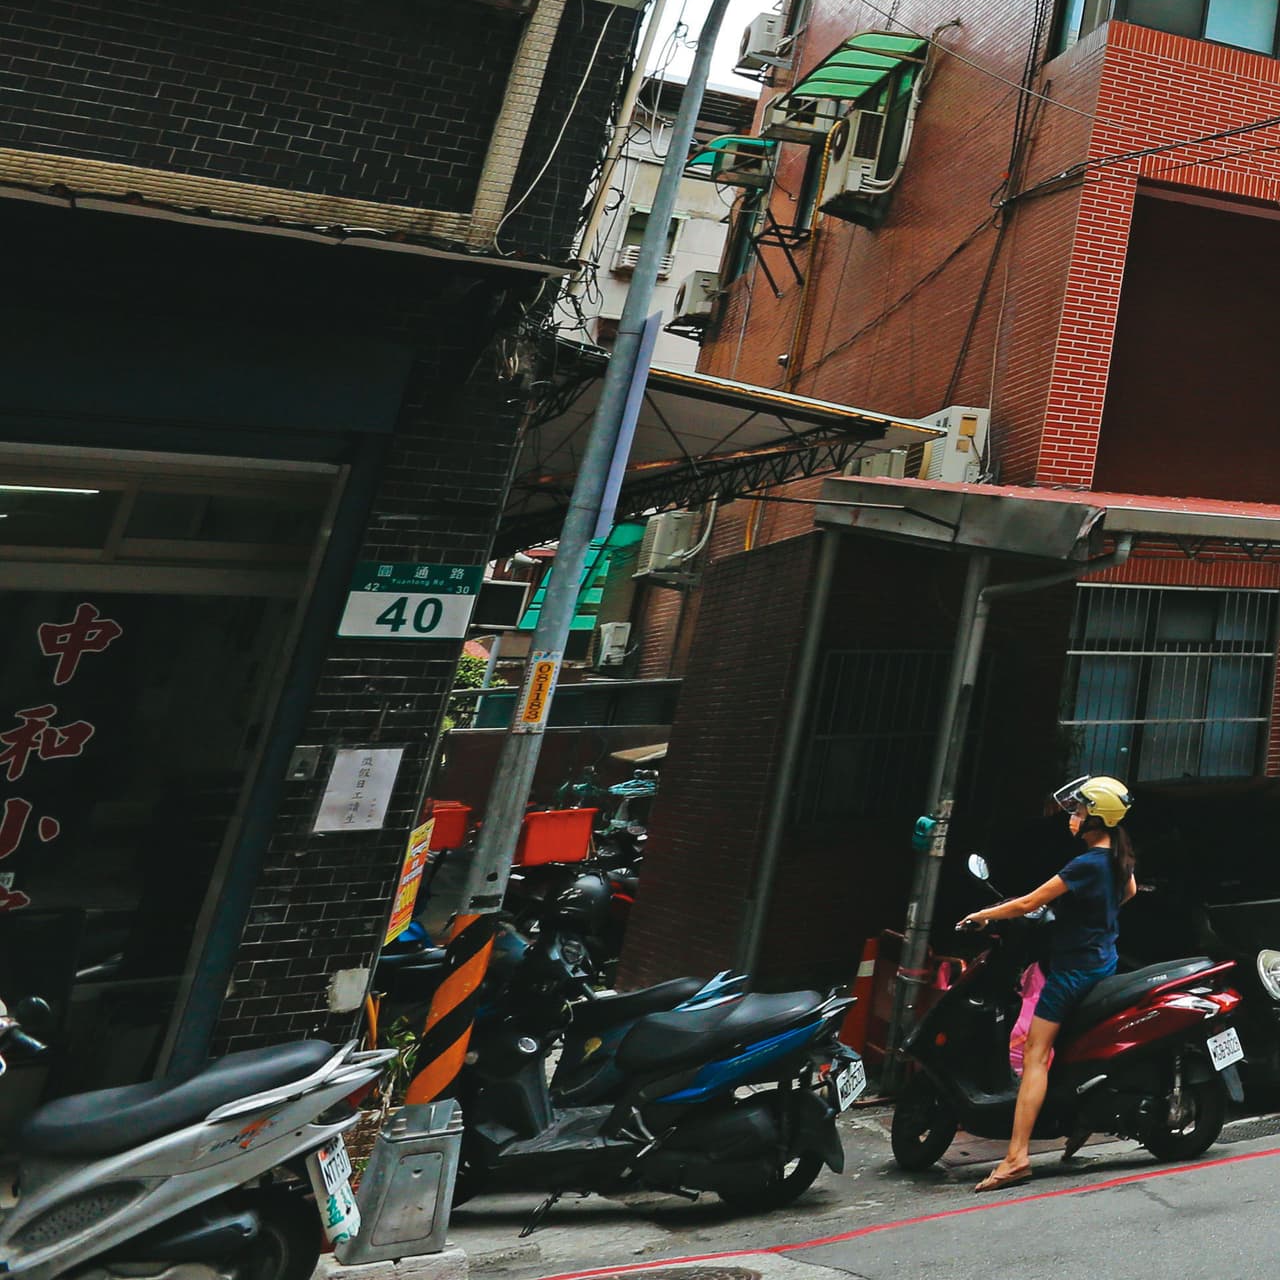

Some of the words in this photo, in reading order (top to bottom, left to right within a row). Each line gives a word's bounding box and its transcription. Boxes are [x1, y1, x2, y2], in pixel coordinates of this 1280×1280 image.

[364, 582, 380, 592] 42
[456, 585, 470, 594] 30
[376, 596, 443, 633] 40
